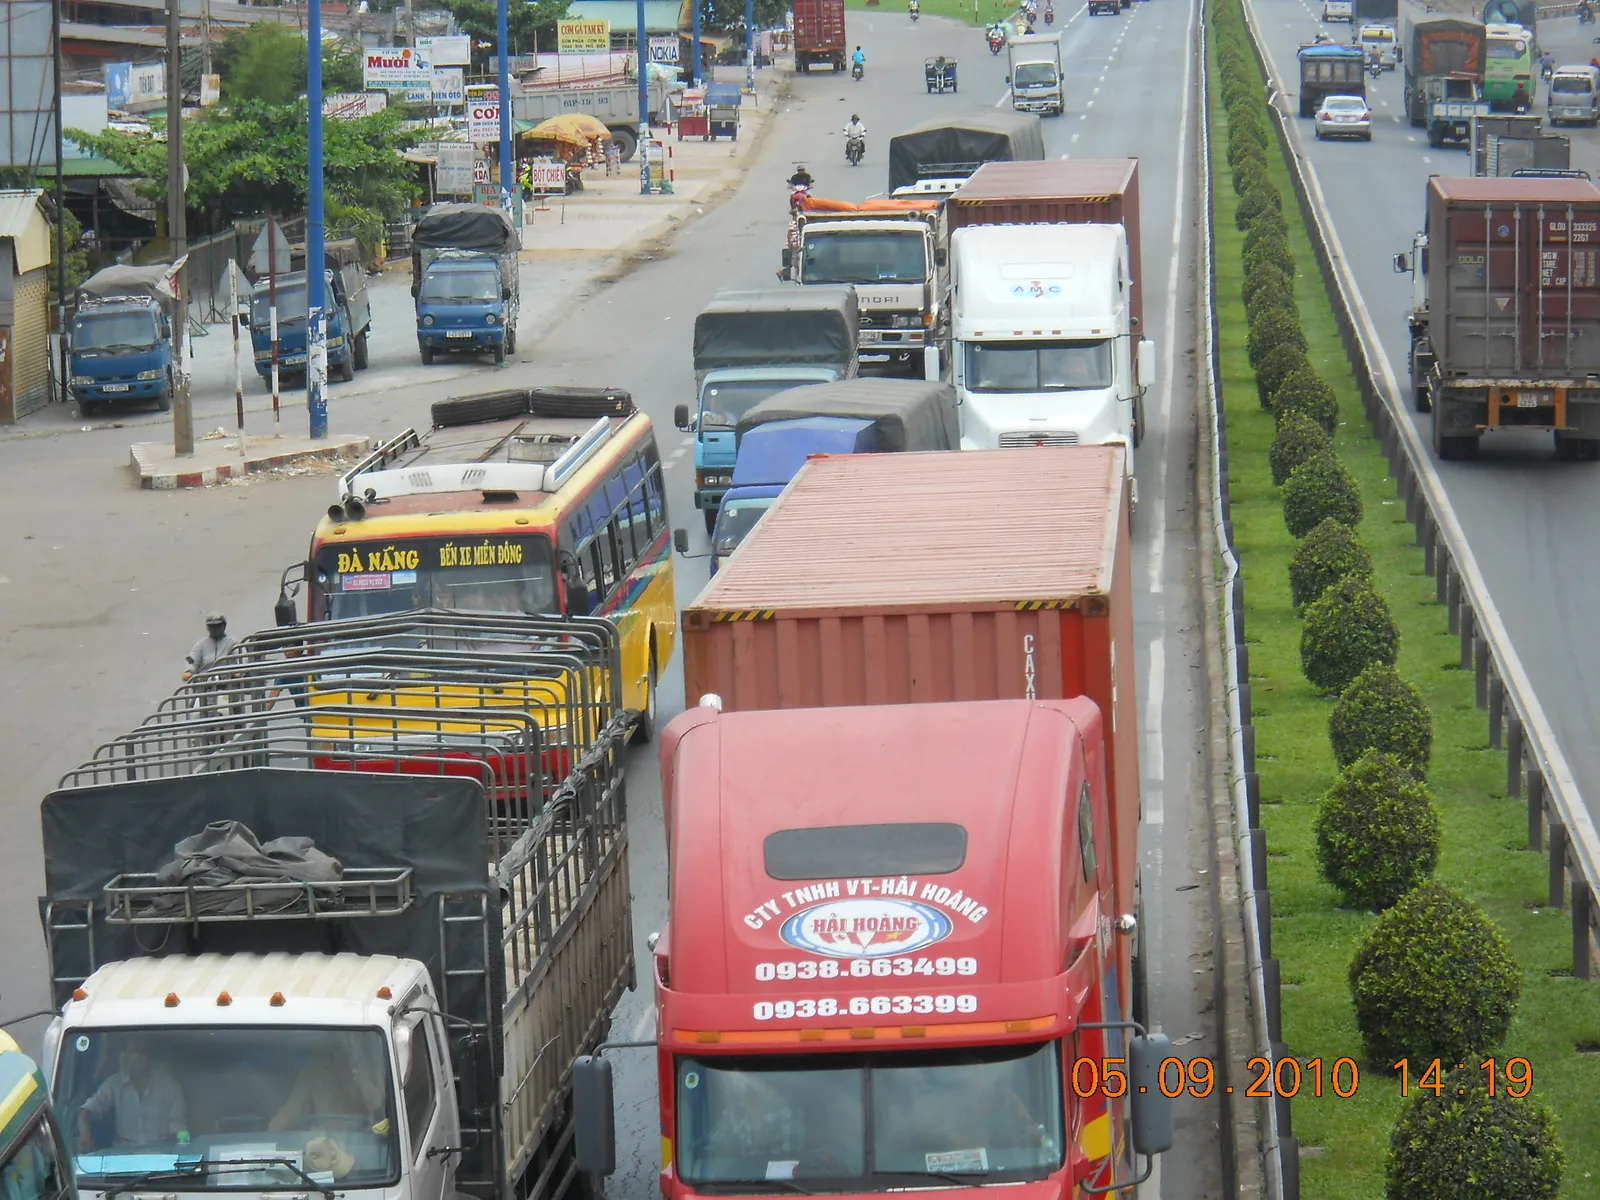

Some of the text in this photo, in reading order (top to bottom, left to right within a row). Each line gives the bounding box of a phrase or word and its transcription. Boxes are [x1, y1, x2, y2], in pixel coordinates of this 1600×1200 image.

[650, 46, 678, 61] NOKIA
[1458, 255, 1485, 264] GOLD
[861, 296, 899, 304] NDAI
[337, 548, 364, 573] ĐÀ
[439, 539, 523, 567] BẾN XE MIỀN ĐÔNG
[743, 898, 782, 931] CTY
[781, 881, 840, 908] TNHH
[920, 883, 989, 924] HOÀNG
[812, 912, 919, 933] HẢI HOÀNG
[755, 957, 978, 982] 0938.663499
[753, 994, 978, 1020] 0938.663399
